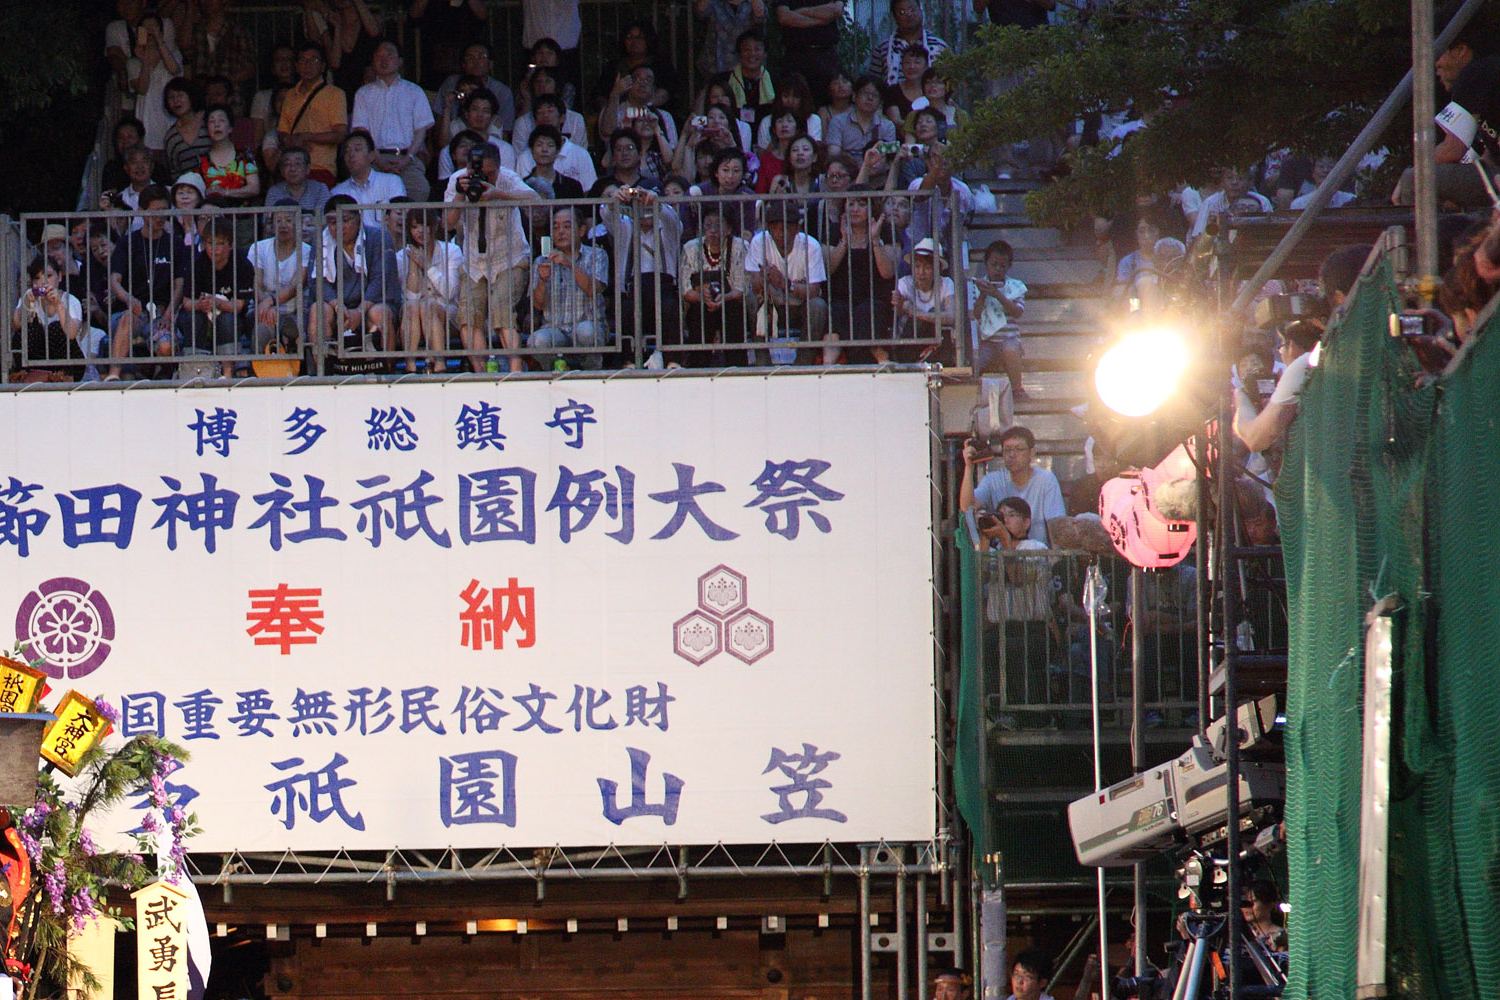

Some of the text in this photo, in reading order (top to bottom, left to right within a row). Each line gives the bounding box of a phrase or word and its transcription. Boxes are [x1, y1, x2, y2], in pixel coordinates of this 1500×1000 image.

[188, 399, 598, 457] 博多総鎮守
[53, 709, 94, 759] 大神宮
[121, 683, 676, 740] 国重要無形民俗文化財
